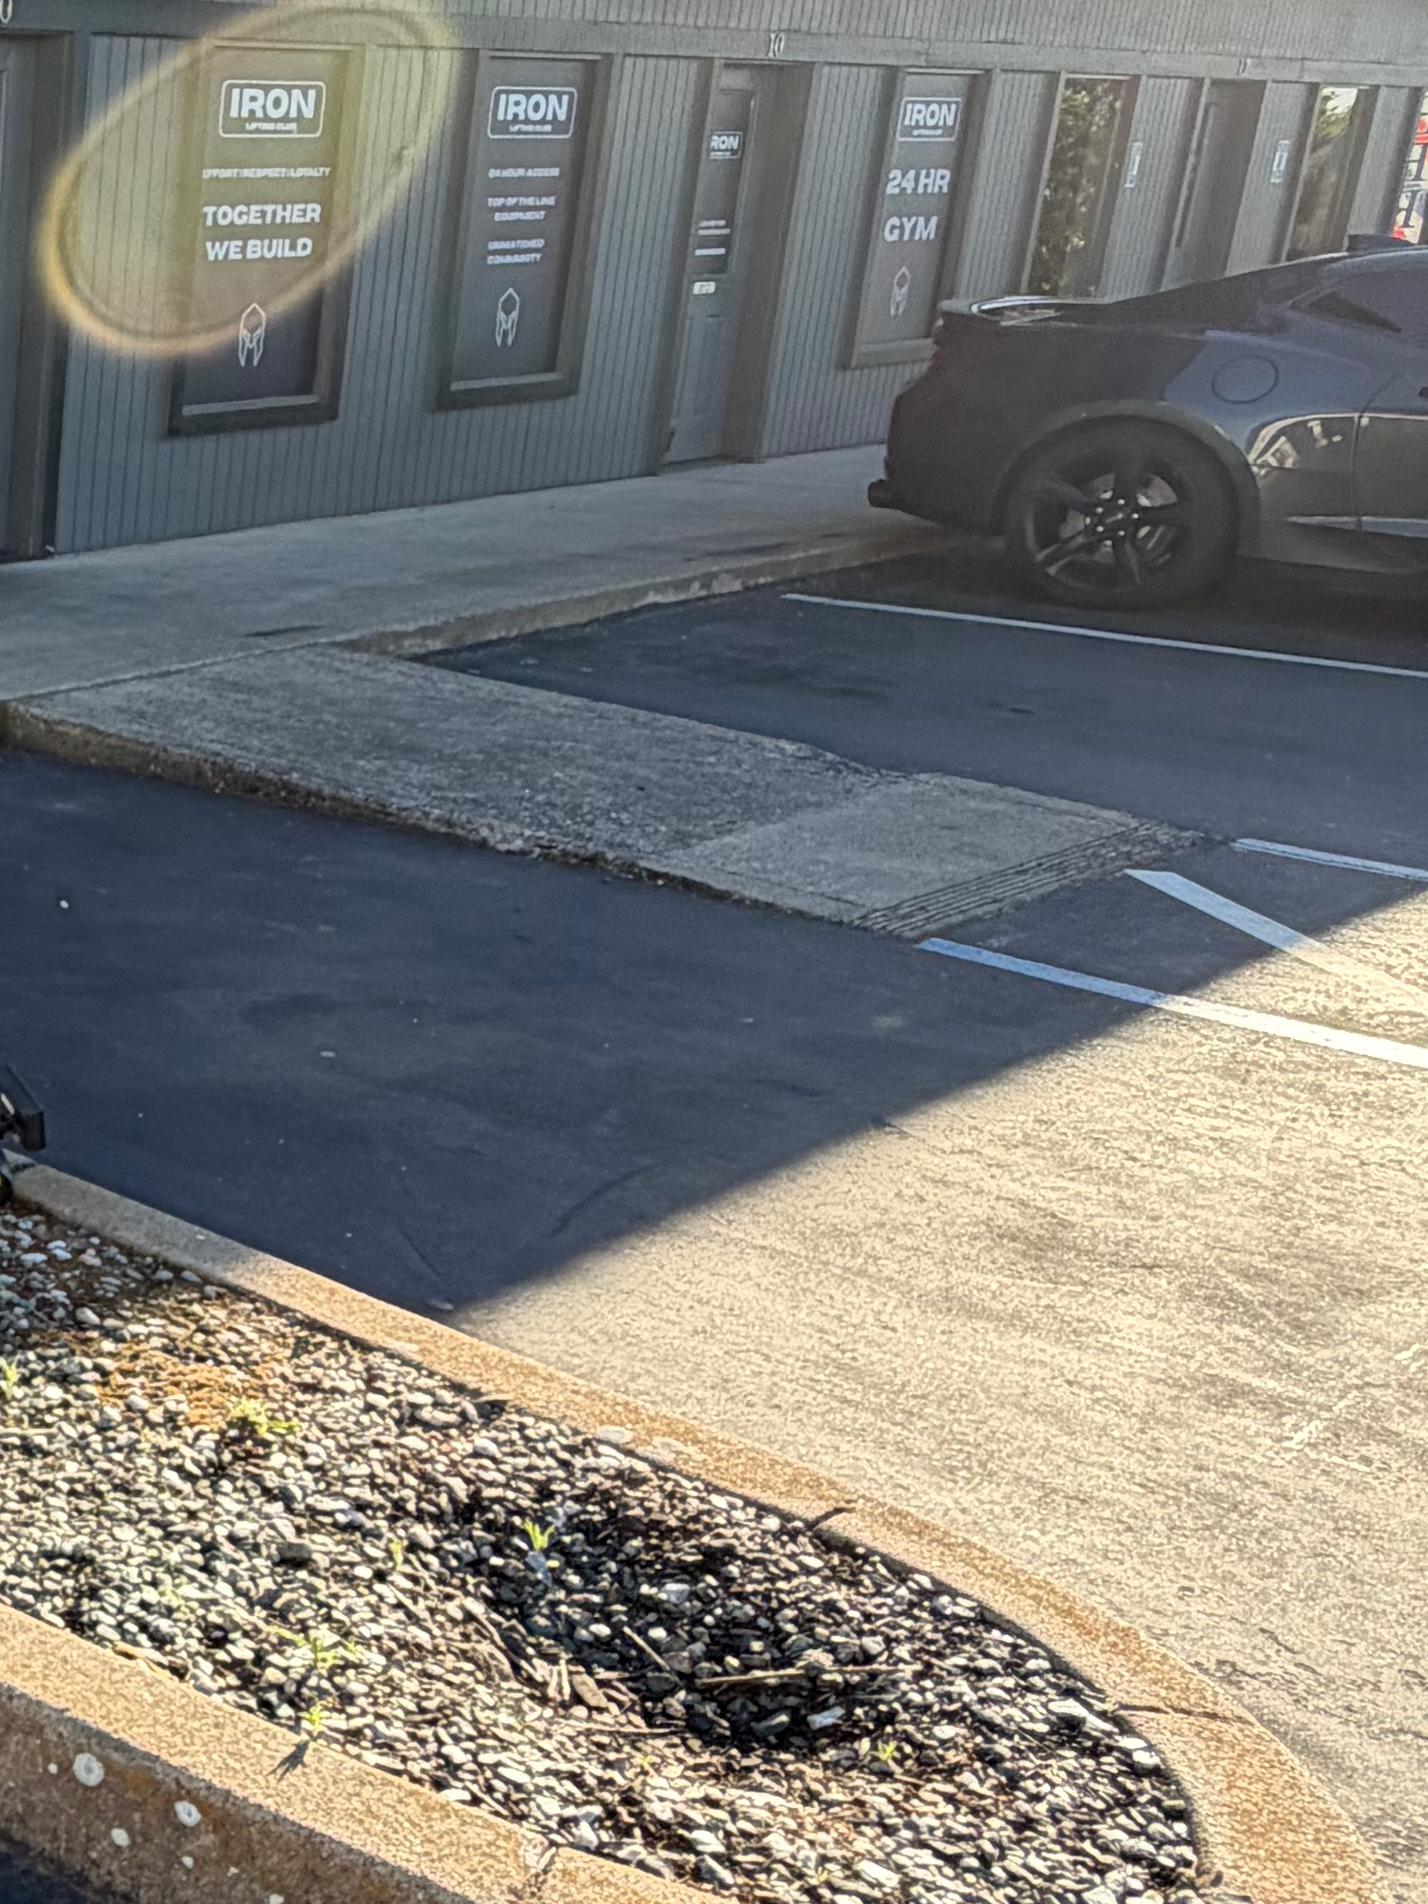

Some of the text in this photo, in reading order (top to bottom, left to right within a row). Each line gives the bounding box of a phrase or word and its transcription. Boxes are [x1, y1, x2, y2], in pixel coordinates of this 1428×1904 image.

[229, 88, 316, 119] IRON
[497, 93, 569, 122] IRON
[904, 103, 957, 127] IRON
[709, 135, 739, 150] RON
[885, 168, 951, 195] 24 HR
[203, 203, 321, 227] TOGETHER
[884, 215, 938, 242] GYM
[205, 237, 313, 261] WE BUILD
